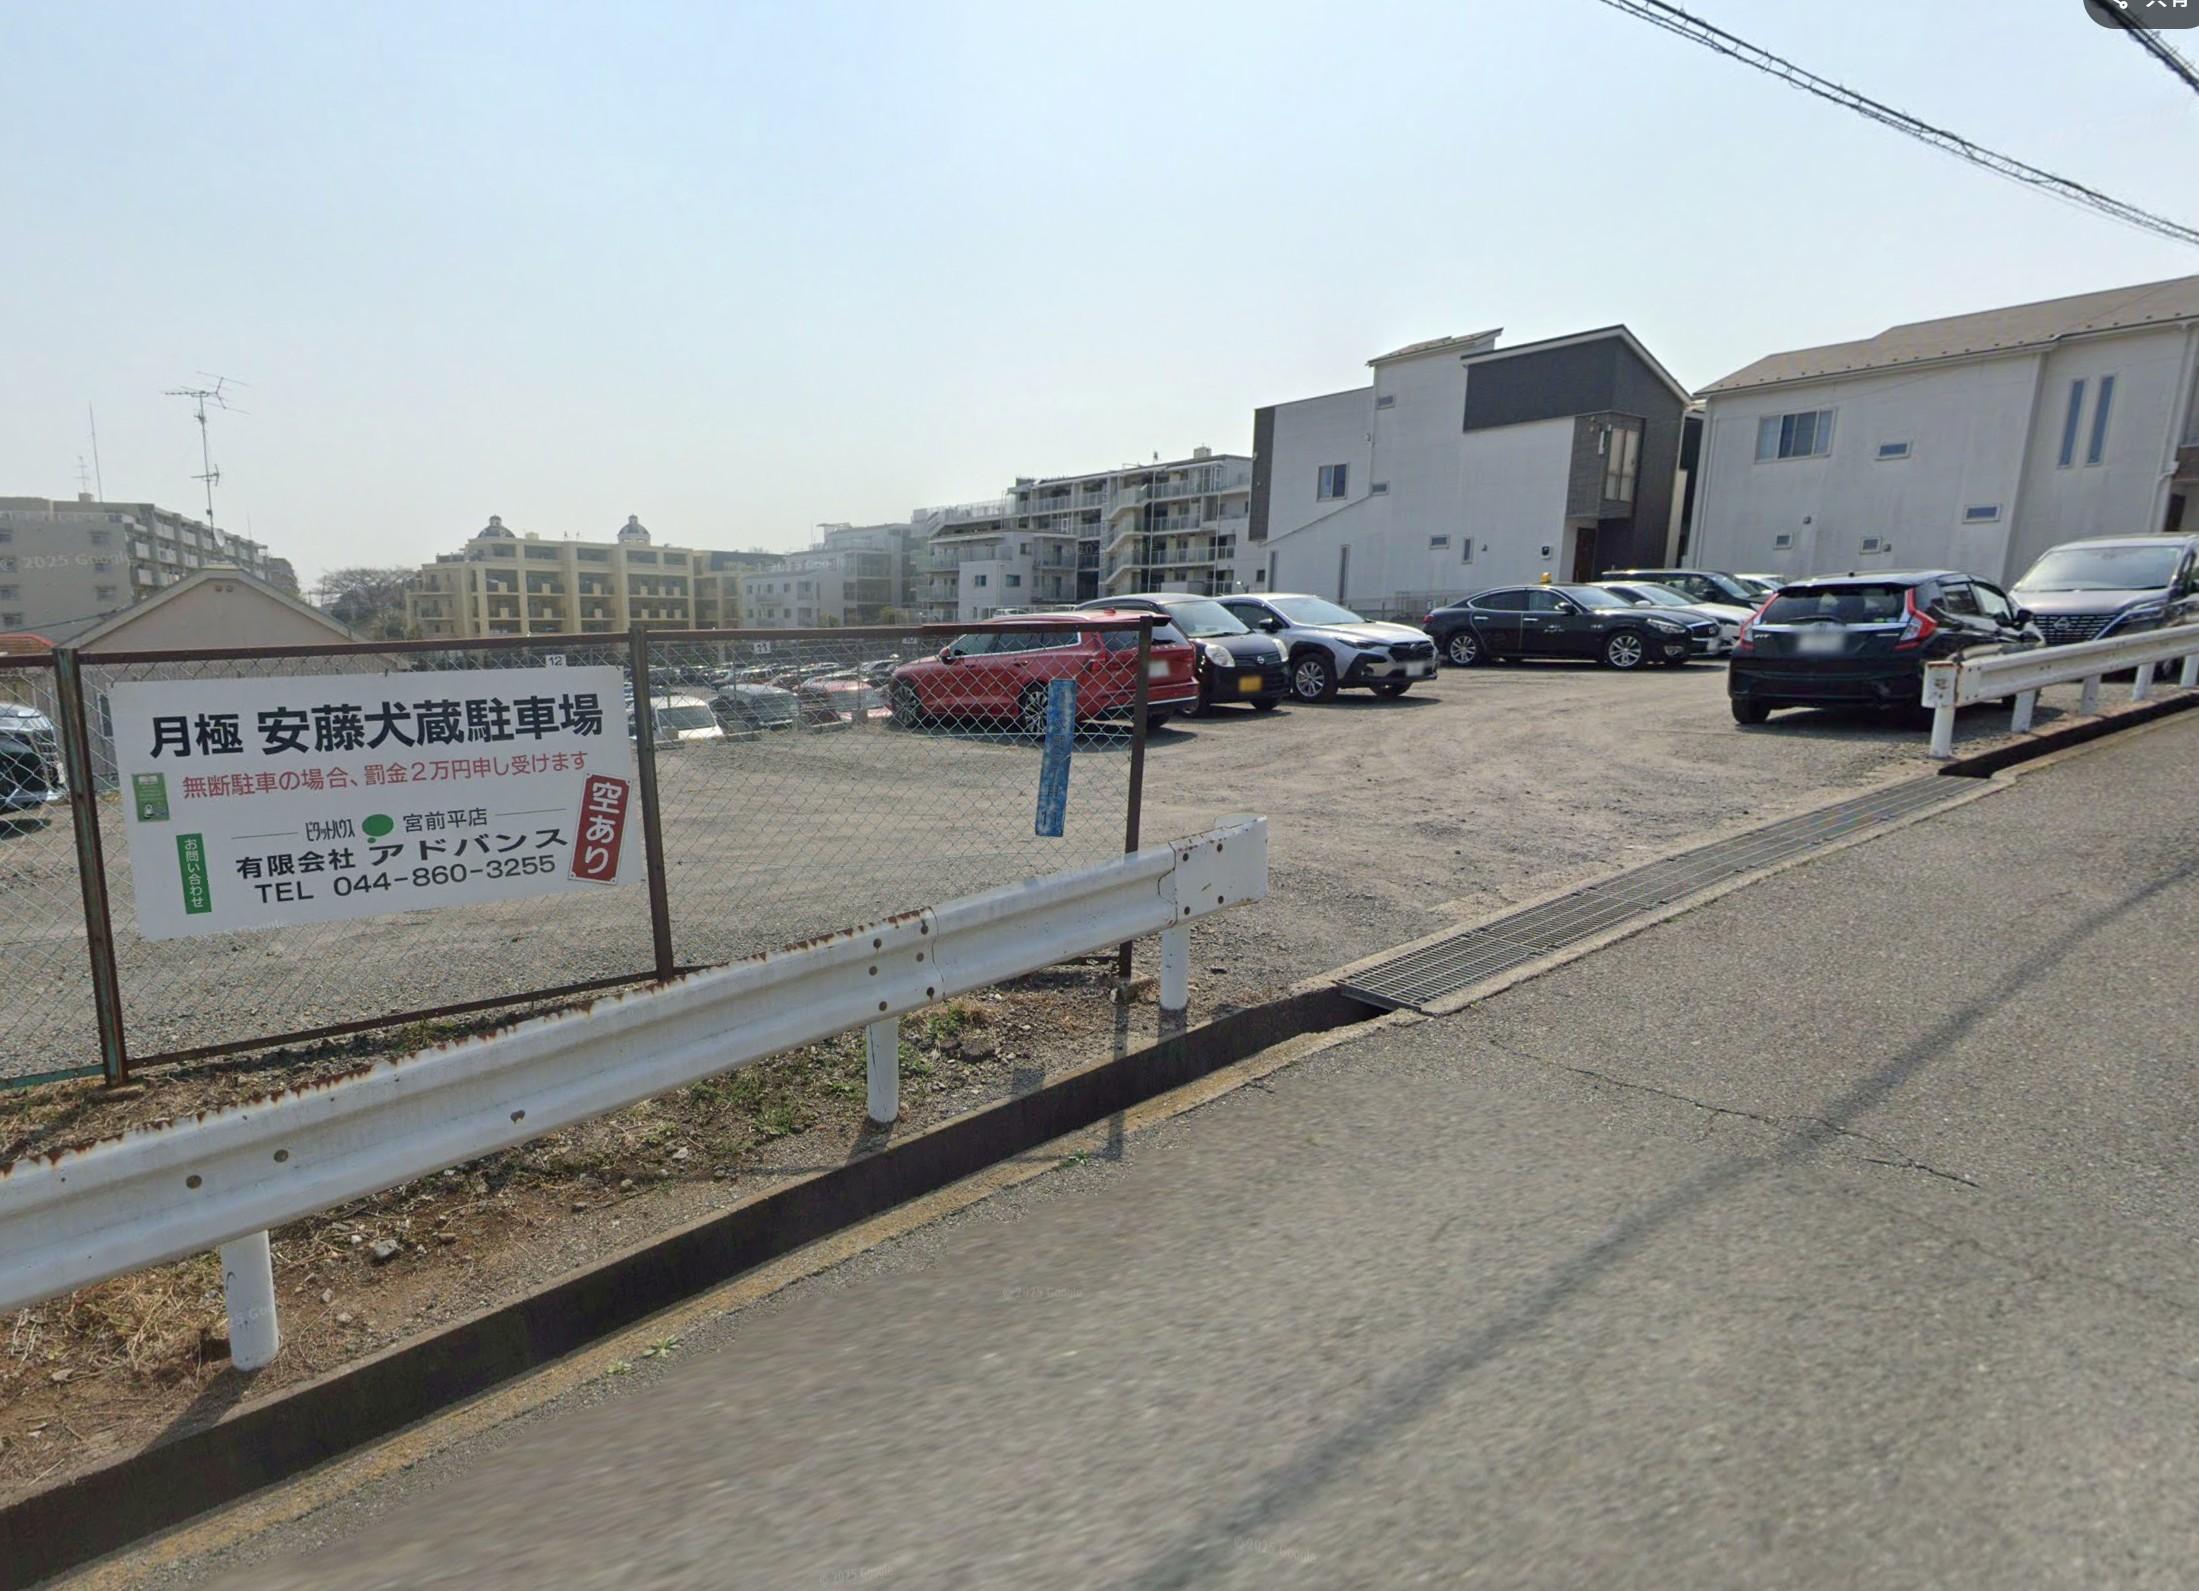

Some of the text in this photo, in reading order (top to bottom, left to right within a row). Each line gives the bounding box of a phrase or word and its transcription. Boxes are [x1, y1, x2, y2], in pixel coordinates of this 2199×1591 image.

[548, 656, 563, 667] 12
[150, 693, 604, 759] 月極 安藤犬蔵駐車場
[403, 807, 488, 833] 宮前平店
[584, 781, 623, 874] 空あり
[184, 838, 204, 909] お問い合わせ
[235, 828, 568, 880] 有限会社 アドバンス
[254, 854, 557, 904] TEL 044-860-3255
